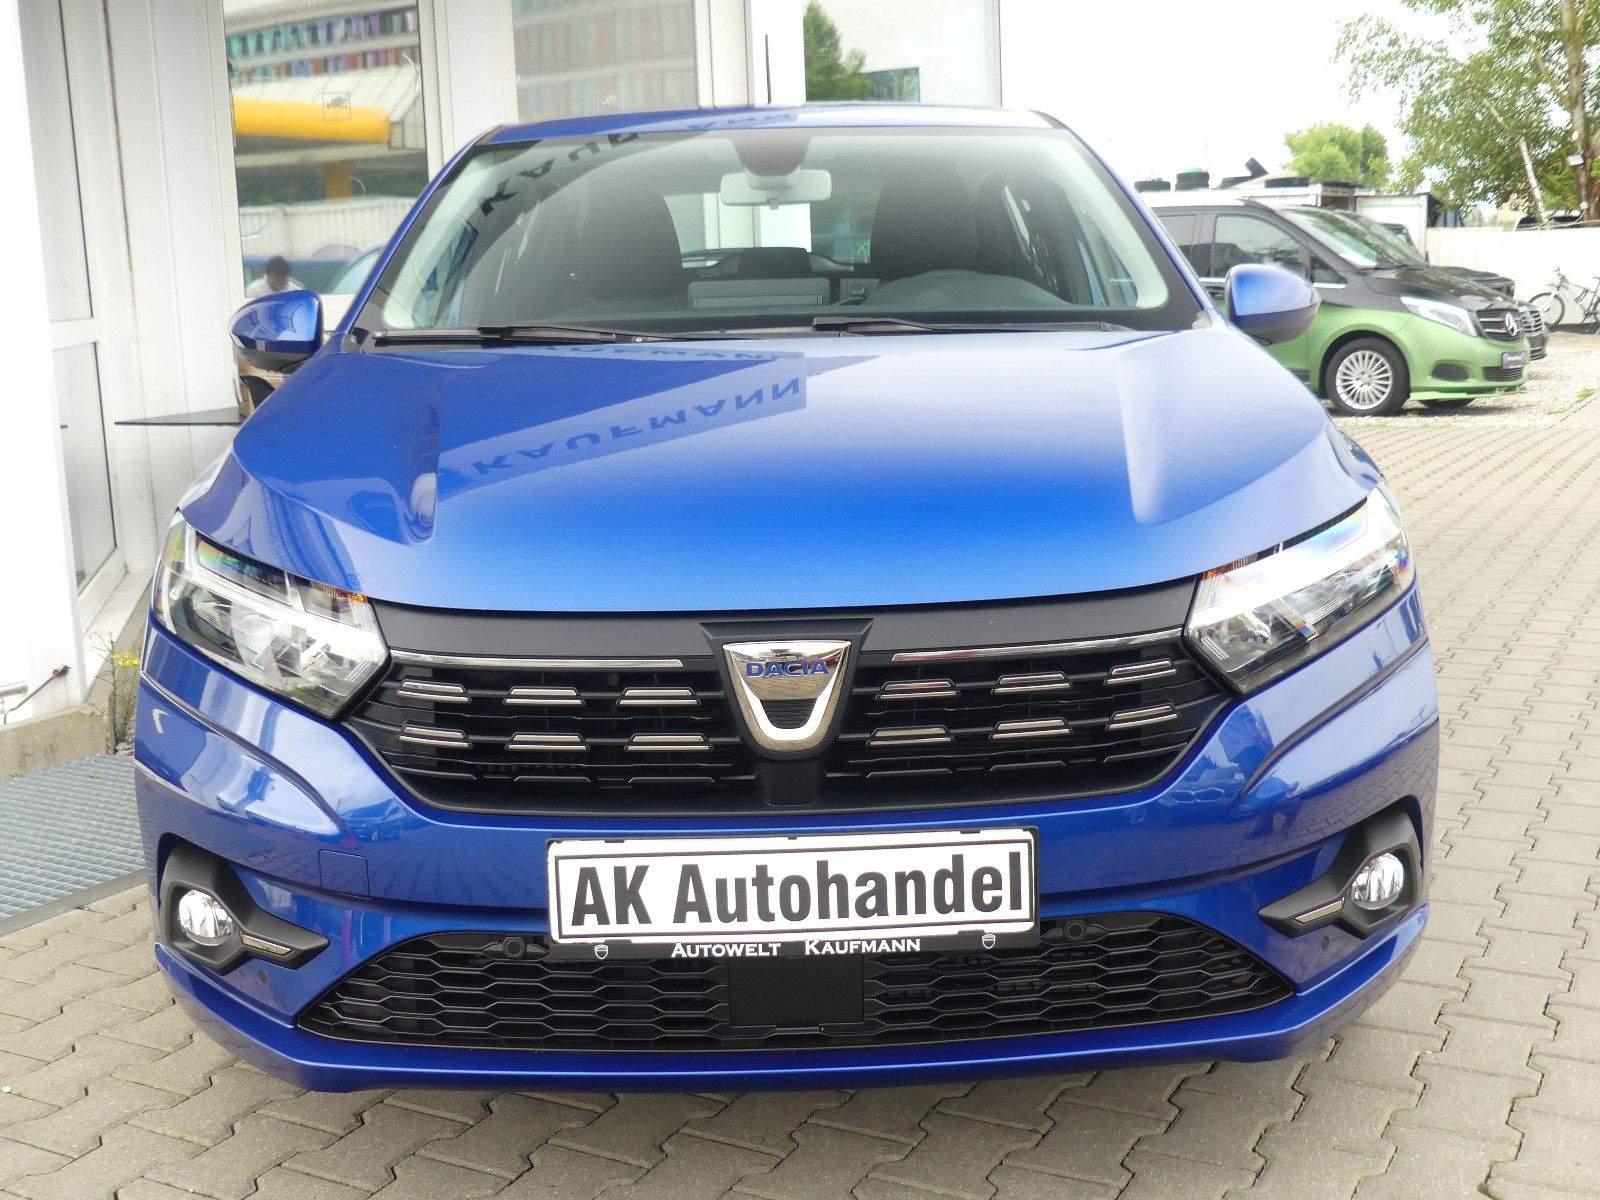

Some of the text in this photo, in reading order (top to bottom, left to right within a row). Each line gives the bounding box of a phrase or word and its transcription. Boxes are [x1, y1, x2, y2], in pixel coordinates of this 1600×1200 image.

[746, 661, 829, 677] DACIA
[571, 851, 1022, 926] AK Autohandel
[671, 938, 921, 958] AUTOWELT KAUFMANN
